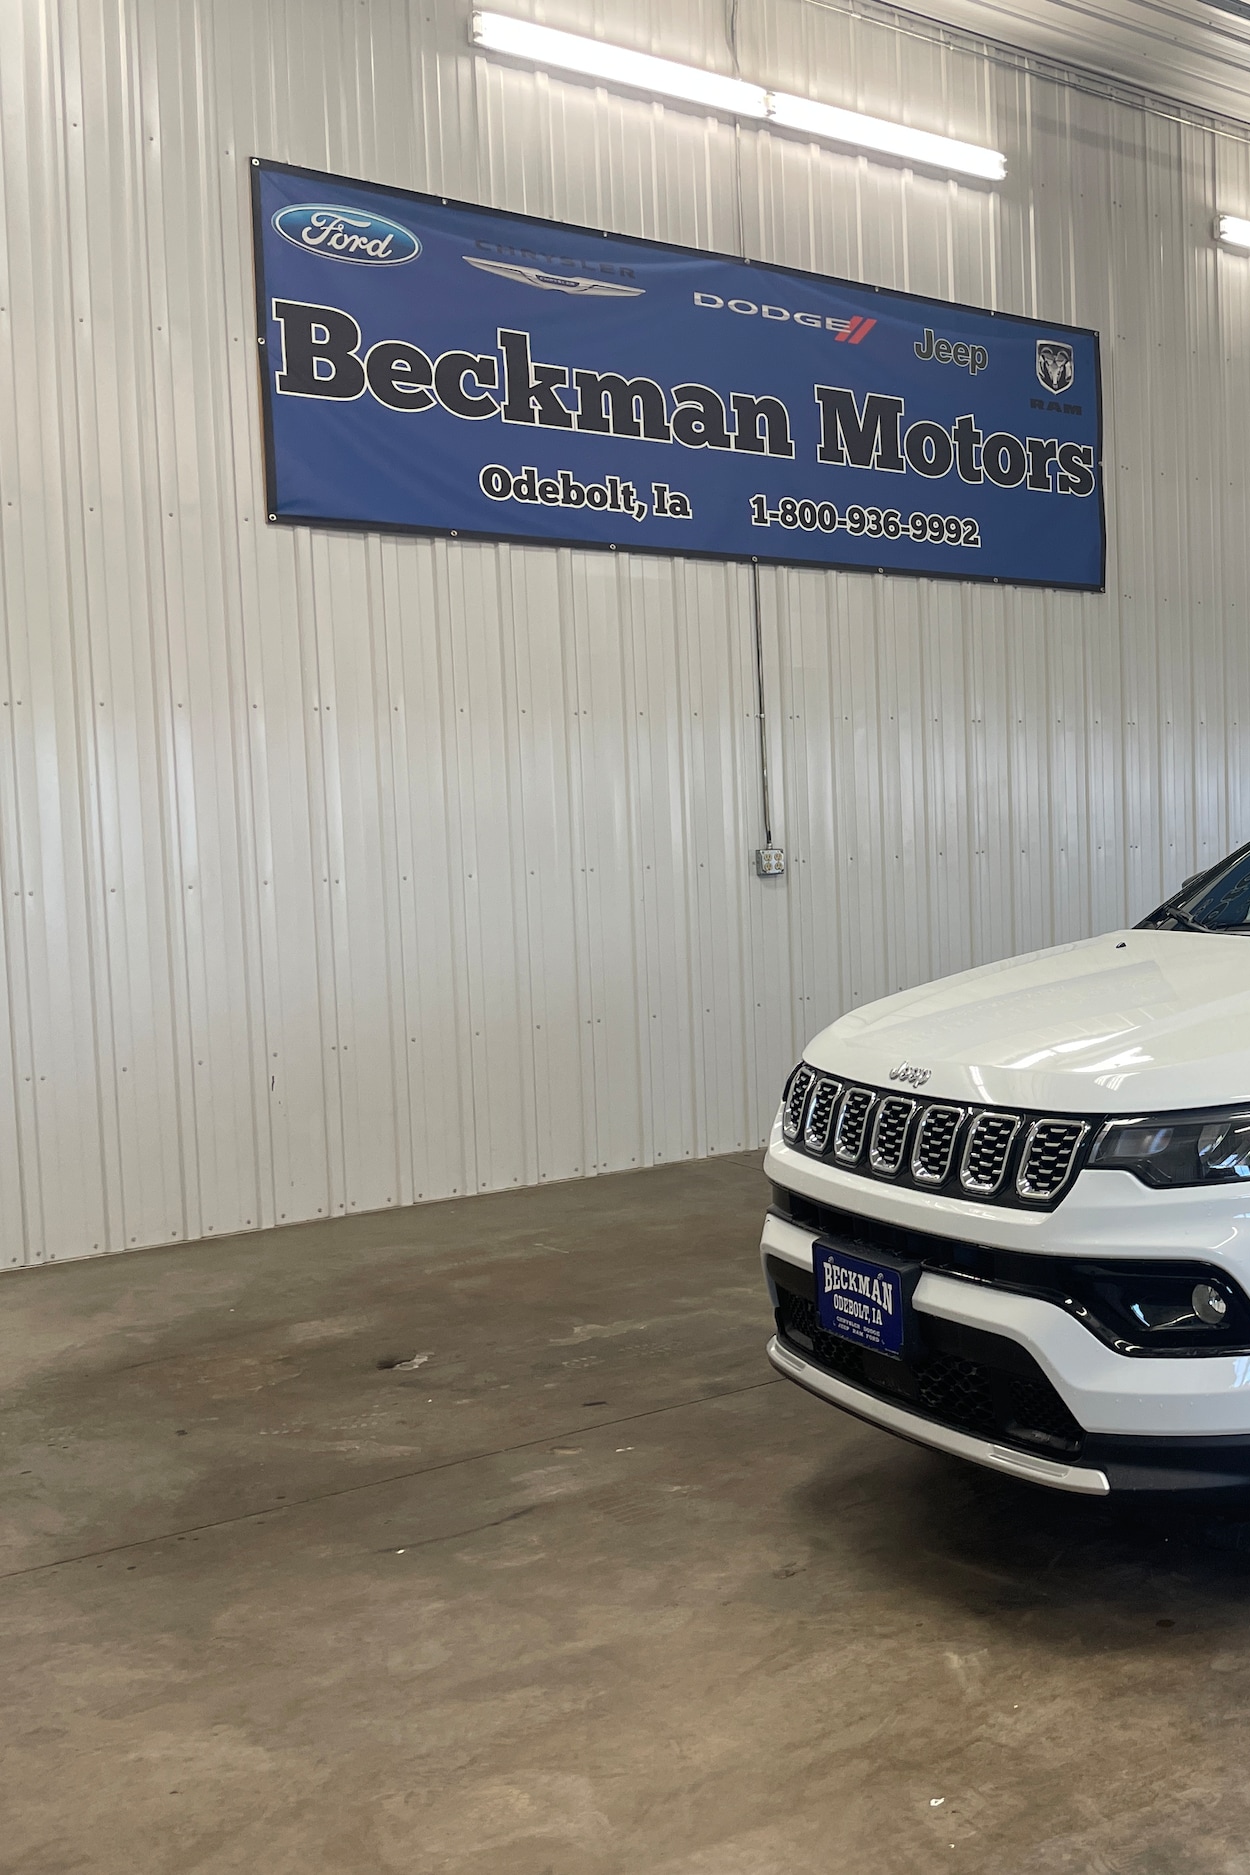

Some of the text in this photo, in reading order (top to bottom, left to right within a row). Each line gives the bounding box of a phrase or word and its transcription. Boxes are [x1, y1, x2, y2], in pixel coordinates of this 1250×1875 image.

[302, 211, 394, 260] Ford
[475, 240, 635, 279] CHRYSLER
[693, 292, 851, 333] DODGE
[914, 329, 988, 375] Jeep
[272, 298, 1095, 497] Beckman Motors
[1030, 399, 1082, 416] RAM
[479, 464, 692, 522] Odebolt, Ia
[750, 494, 981, 548] 1-800-936-9992
[889, 1061, 931, 1088] Jeep
[823, 1261, 893, 1315] BECKMAN
[833, 1293, 883, 1326] ODEBOLT, IA
